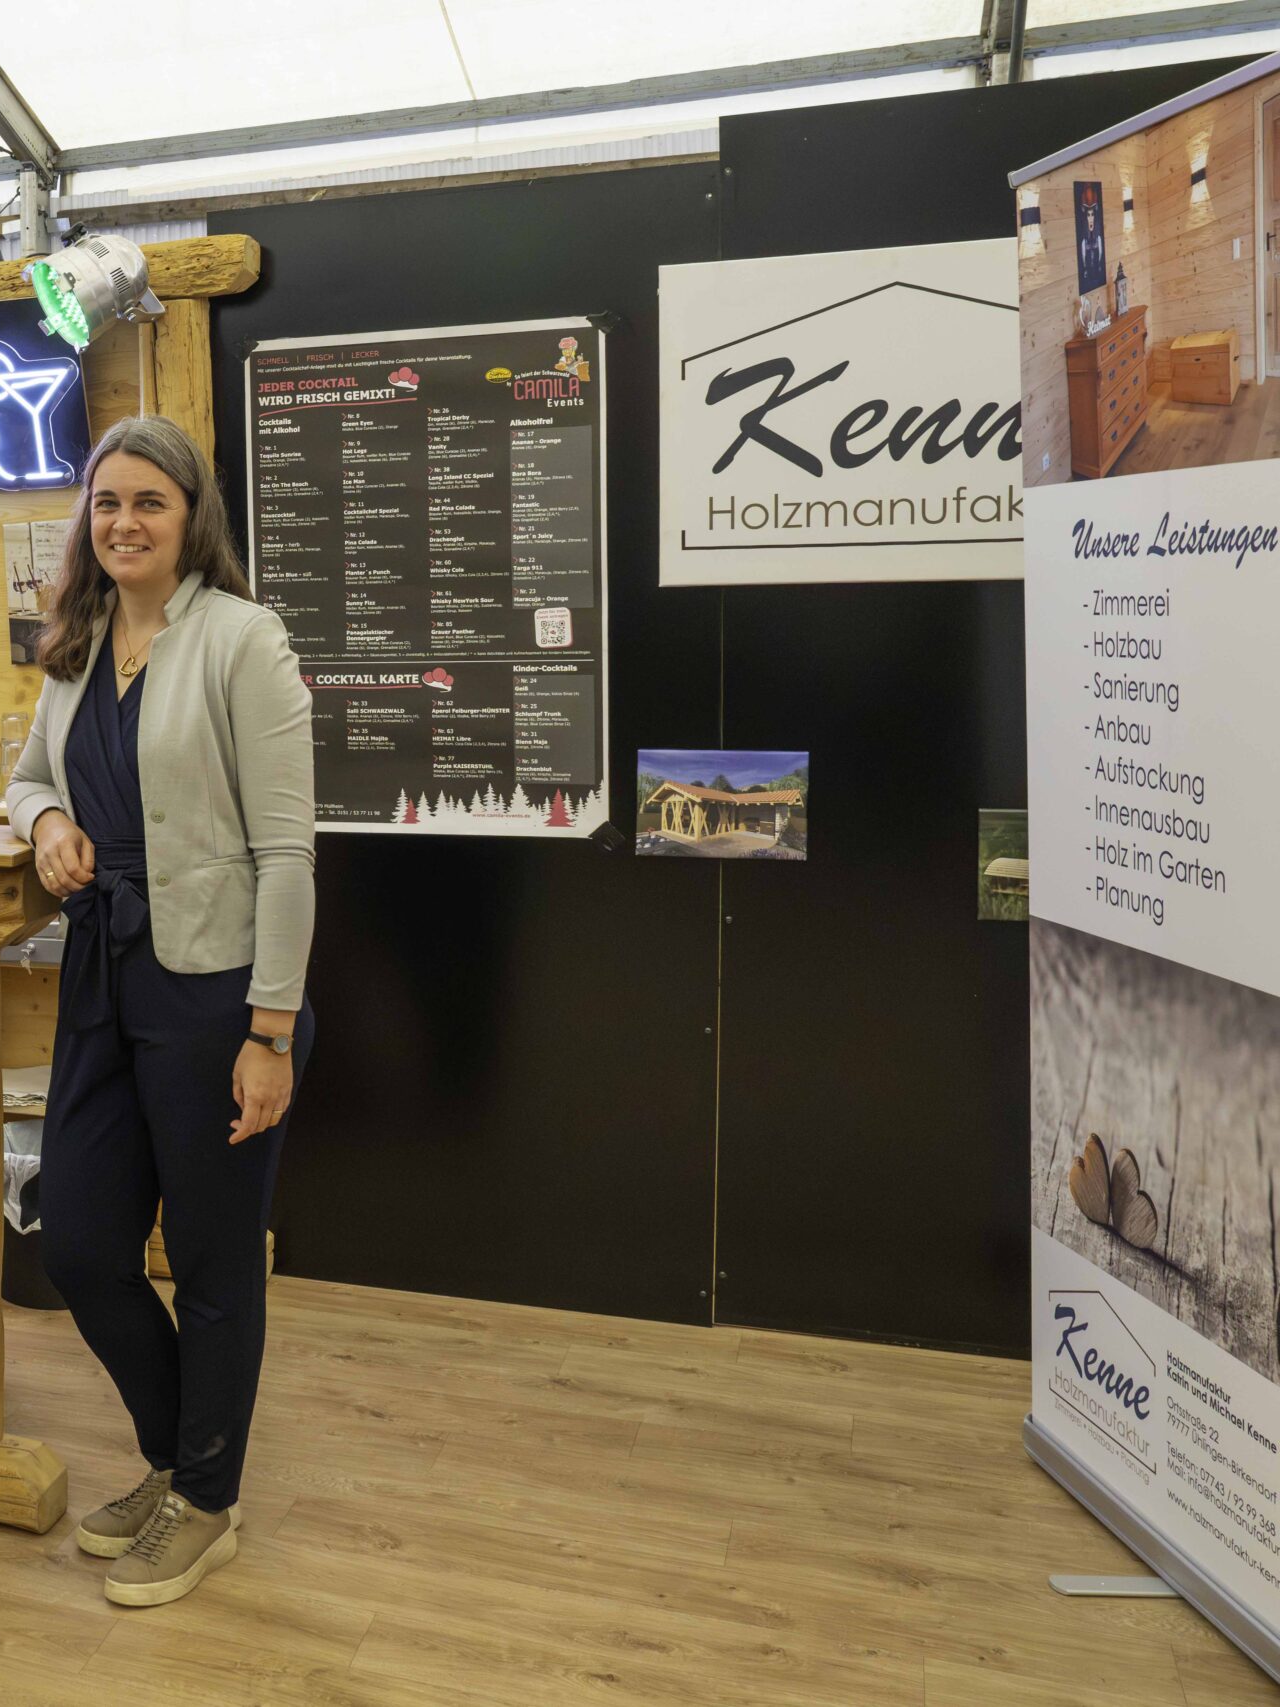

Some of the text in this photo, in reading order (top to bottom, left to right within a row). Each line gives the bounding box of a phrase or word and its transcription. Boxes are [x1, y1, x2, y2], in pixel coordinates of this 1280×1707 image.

[258, 350, 379, 366] SCHNELL FRISCH LECKER
[258, 377, 358, 392] JEDER COCKTAIL
[258, 388, 396, 406] WIRD FRISCH GEMIXT!
[514, 377, 580, 400] CAMILA
[547, 398, 584, 408] Events
[259, 418, 292, 426] Cocktails
[510, 418, 553, 426] Alkoholfrei
[705, 356, 1022, 478] Kenn
[708, 484, 1023, 530] Holzmanufak
[1072, 511, 1278, 570] Unsere Leistungen
[1092, 588, 1170, 617] Zimmerei
[1094, 631, 1162, 660] Holzbau
[316, 674, 376, 684] COCKTAIL
[380, 674, 419, 684] KARTE
[1094, 672, 1180, 712] Sanierung
[1094, 714, 1151, 746] Anbau
[1094, 755, 1205, 804] Aufstockung
[1095, 796, 1211, 844] Innenausbau
[1096, 835, 1226, 894] Holz im Garten
[1096, 876, 1165, 926] Planung
[1054, 1304, 1150, 1420] Kenne
[1166, 1350, 1231, 1405] Holzmanufaktur
[1055, 1366, 1150, 1456] Holzmanufaktur
[1166, 1366, 1277, 1454] Katrin und Michael Kenne
[1166, 1396, 1220, 1444] Ortsstraße 22
[1120, 1449, 1150, 1486] Planung
[1167, 1412, 1277, 1504] 79777 Ühlingen-Birkendorf
[1166, 1441, 1198, 1476] Telefon:
[1200, 1468, 1225, 1497] 07743
[1234, 1494, 1245, 1512] 92
[1246, 1502, 1257, 1520] 99
[1260, 1514, 1276, 1537] 368
[1167, 1458, 1280, 1556] Mail: info@holzmanufaktur
